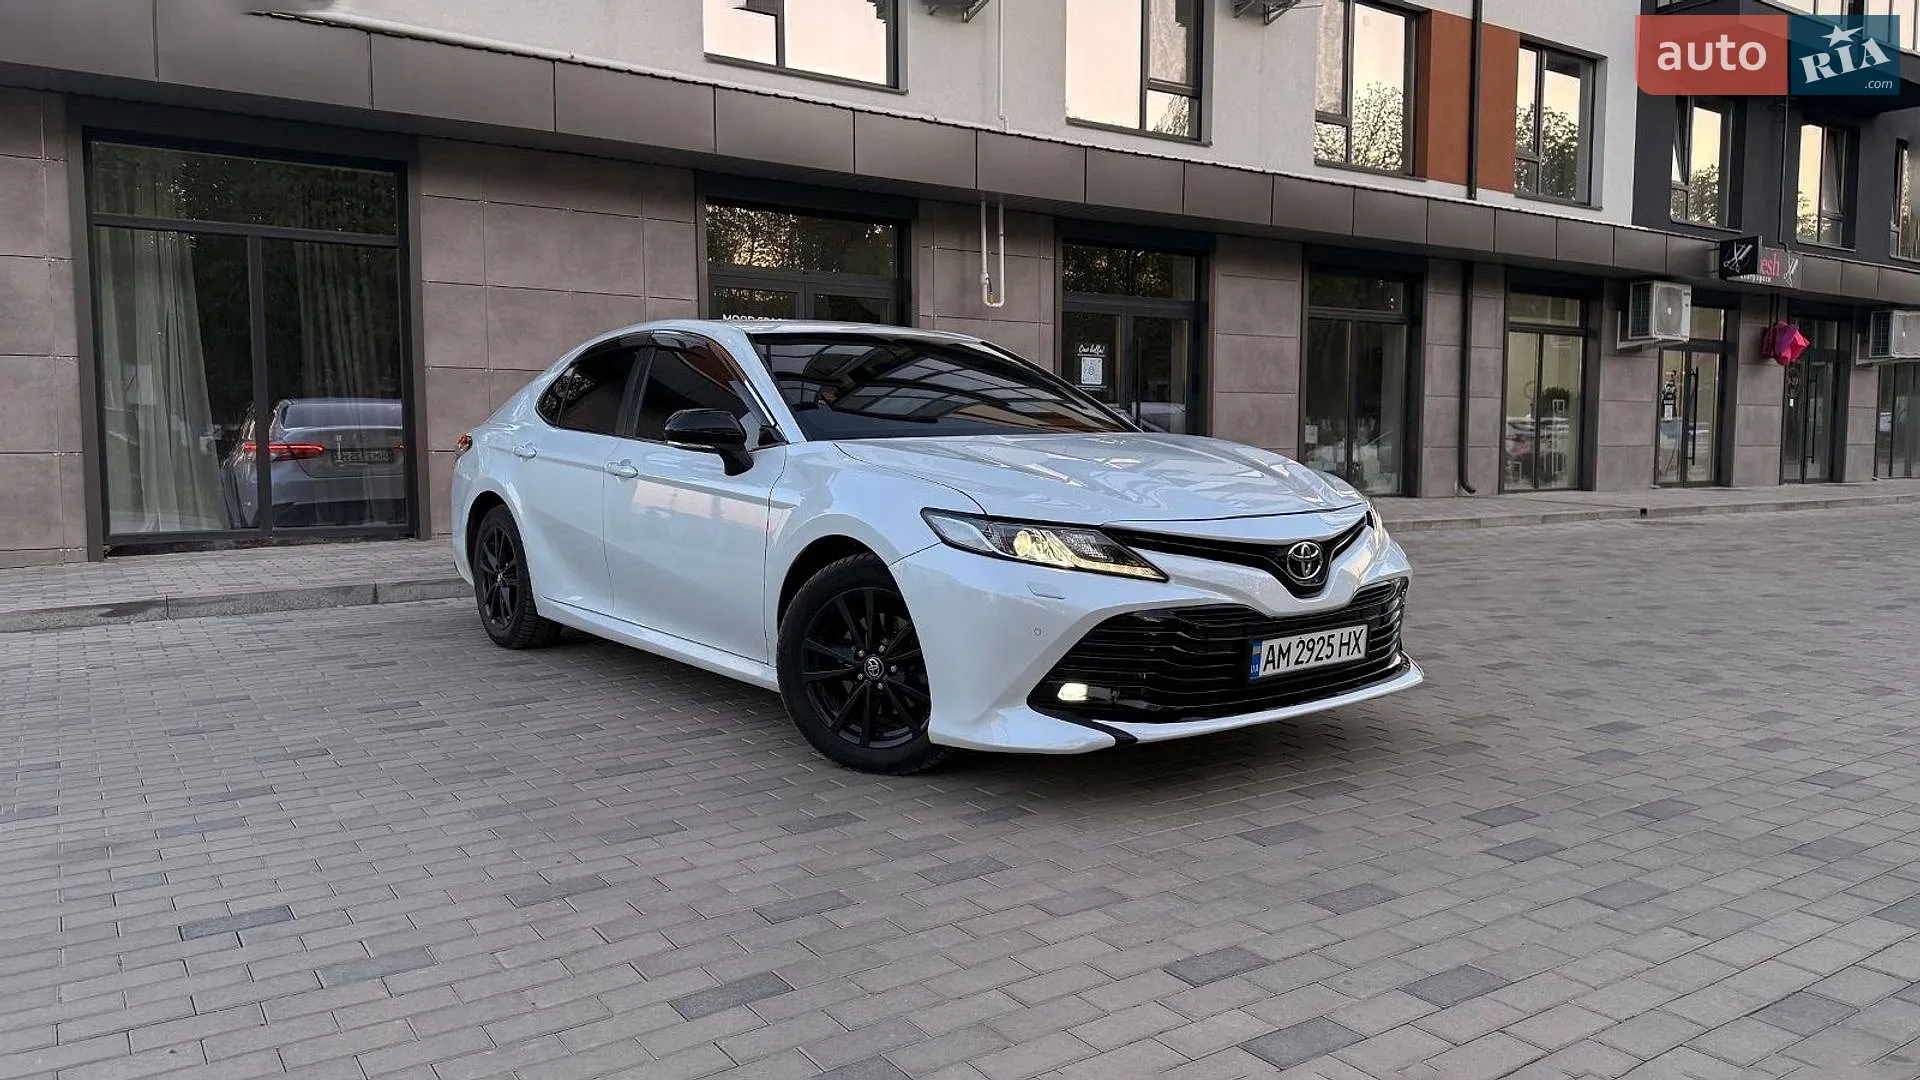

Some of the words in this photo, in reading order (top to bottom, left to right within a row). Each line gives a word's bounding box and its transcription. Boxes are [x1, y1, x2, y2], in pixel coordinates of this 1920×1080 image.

[1263, 642, 1292, 672] AM
[1294, 633, 1336, 666] 2925
[1338, 629, 1364, 657] HX
